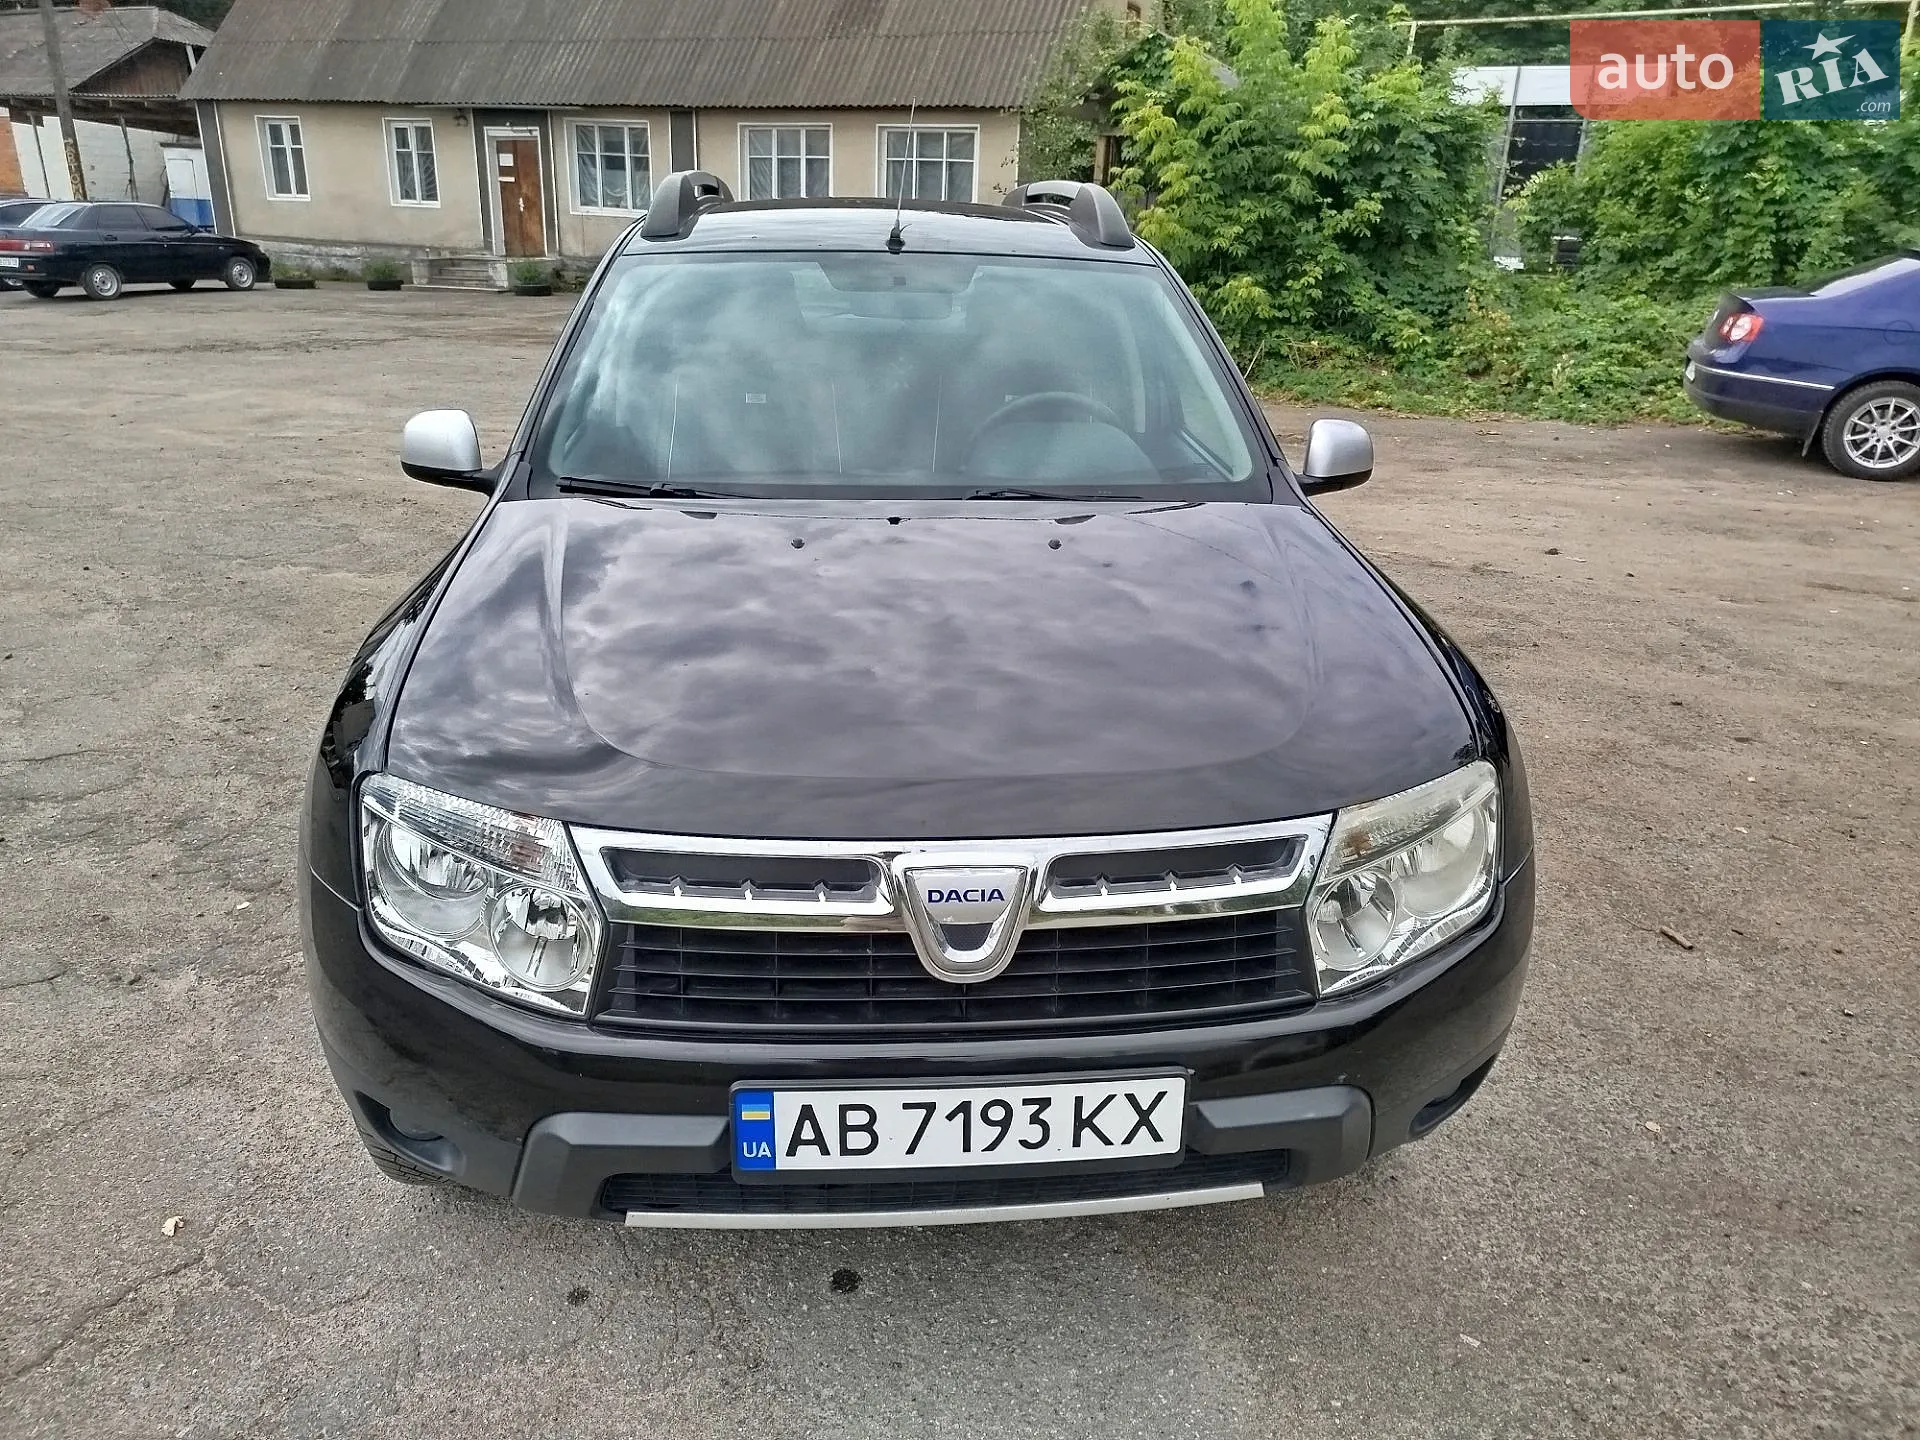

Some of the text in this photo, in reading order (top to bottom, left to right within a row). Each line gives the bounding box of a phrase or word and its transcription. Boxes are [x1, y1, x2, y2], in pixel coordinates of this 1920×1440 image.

[927, 888, 1005, 903] DACIA
[785, 1091, 1169, 1157] AB 7193 KX
[742, 1141, 772, 1158] UA
